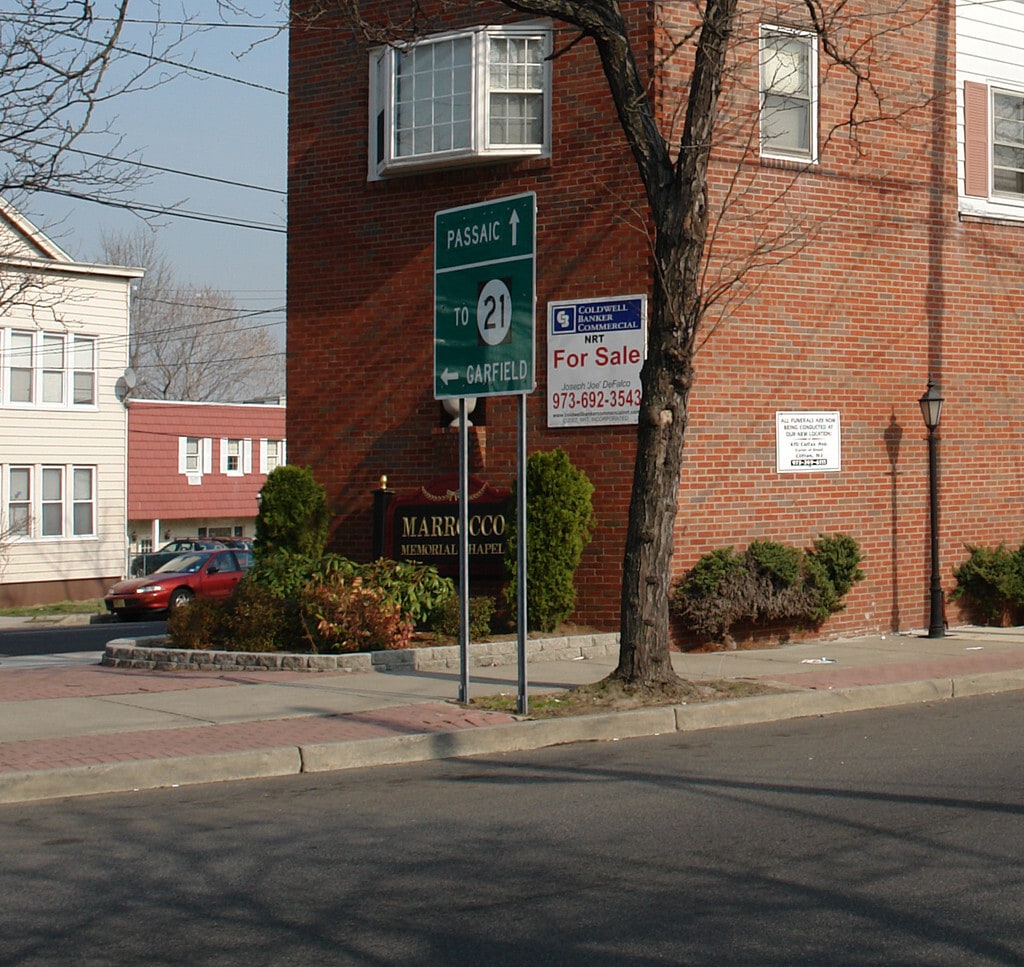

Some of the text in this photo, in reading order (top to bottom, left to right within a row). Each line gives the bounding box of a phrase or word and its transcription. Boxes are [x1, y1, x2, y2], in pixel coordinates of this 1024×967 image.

[447, 221, 500, 249] PASSAIC
[454, 306, 469, 326] TO
[483, 293, 505, 330] 21
[578, 304, 628, 314] COLDWELL
[578, 314, 613, 323] BANKER
[578, 321, 638, 332] COMMERCIAL
[584, 334, 604, 344] NRT
[554, 345, 640, 369] For Sale
[466, 359, 527, 385] GARFIELD
[561, 382, 586, 391] Joseph
[602, 379, 631, 389] DeFalco
[553, 389, 641, 409] 973-692-3543
[402, 514, 505, 537] MARRCCO
[400, 543, 505, 555] MEMORIAL HAPEL
